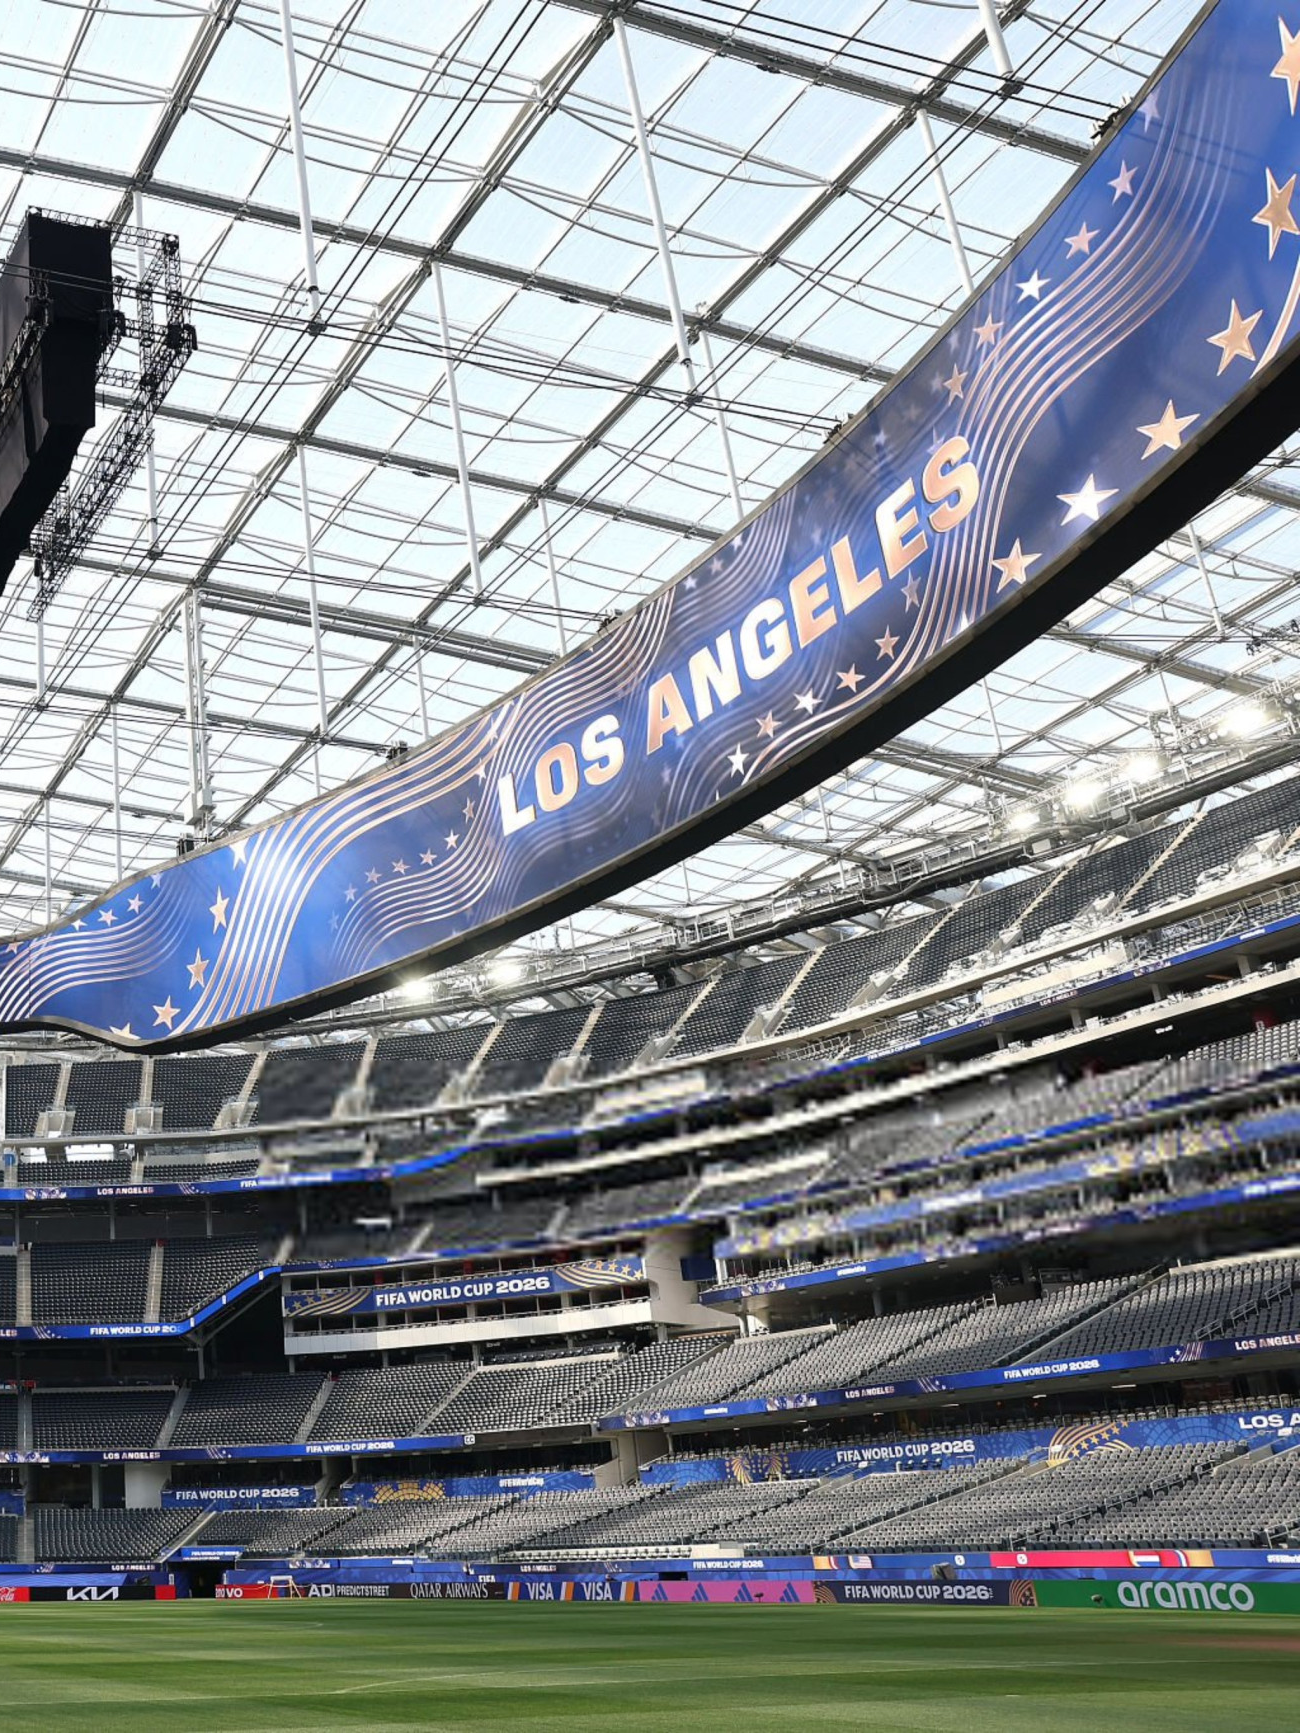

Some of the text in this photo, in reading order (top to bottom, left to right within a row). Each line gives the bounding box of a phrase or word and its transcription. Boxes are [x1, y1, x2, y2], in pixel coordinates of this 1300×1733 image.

[500, 436, 981, 837] LOS ANGELES
[115, 1186, 154, 1195] ANGELES
[376, 1276, 550, 1307] FIFA WORLD CUP 2026
[90, 1327, 109, 1336] FIFA
[110, 1326, 142, 1335] WORLD
[143, 1325, 160, 1334] CUP
[1235, 1339, 1257, 1351] LOS
[1004, 1369, 1023, 1379] FIFA
[1023, 1366, 1051, 1377] WORLD
[1051, 1364, 1069, 1374] CUP
[845, 1385, 895, 1399] LOS ANGELES
[1238, 1413, 1284, 1429] LOS
[306, 1445, 323, 1453] FIFA
[323, 1443, 350, 1452] WORLD
[350, 1442, 366, 1451] CUP
[836, 1439, 975, 1463] FIFA WORLD CUP 2026
[103, 1451, 161, 1460] LOS ANGELES
[176, 1487, 300, 1501] FIFA WORLD CUP 2026
[693, 1560, 706, 1568] FIFA
[706, 1560, 729, 1568] WORLD
[729, 1560, 741, 1568] CUP
[337, 1585, 390, 1596] PREDICTSTREET
[410, 1583, 489, 1599] QATAR AIRWAYS
[525, 1582, 554, 1600] VISA
[581, 1582, 614, 1600] VISA
[844, 1585, 990, 1600] FIFA WORLD CUP 2026
[1117, 1581, 1255, 1611] aramco
